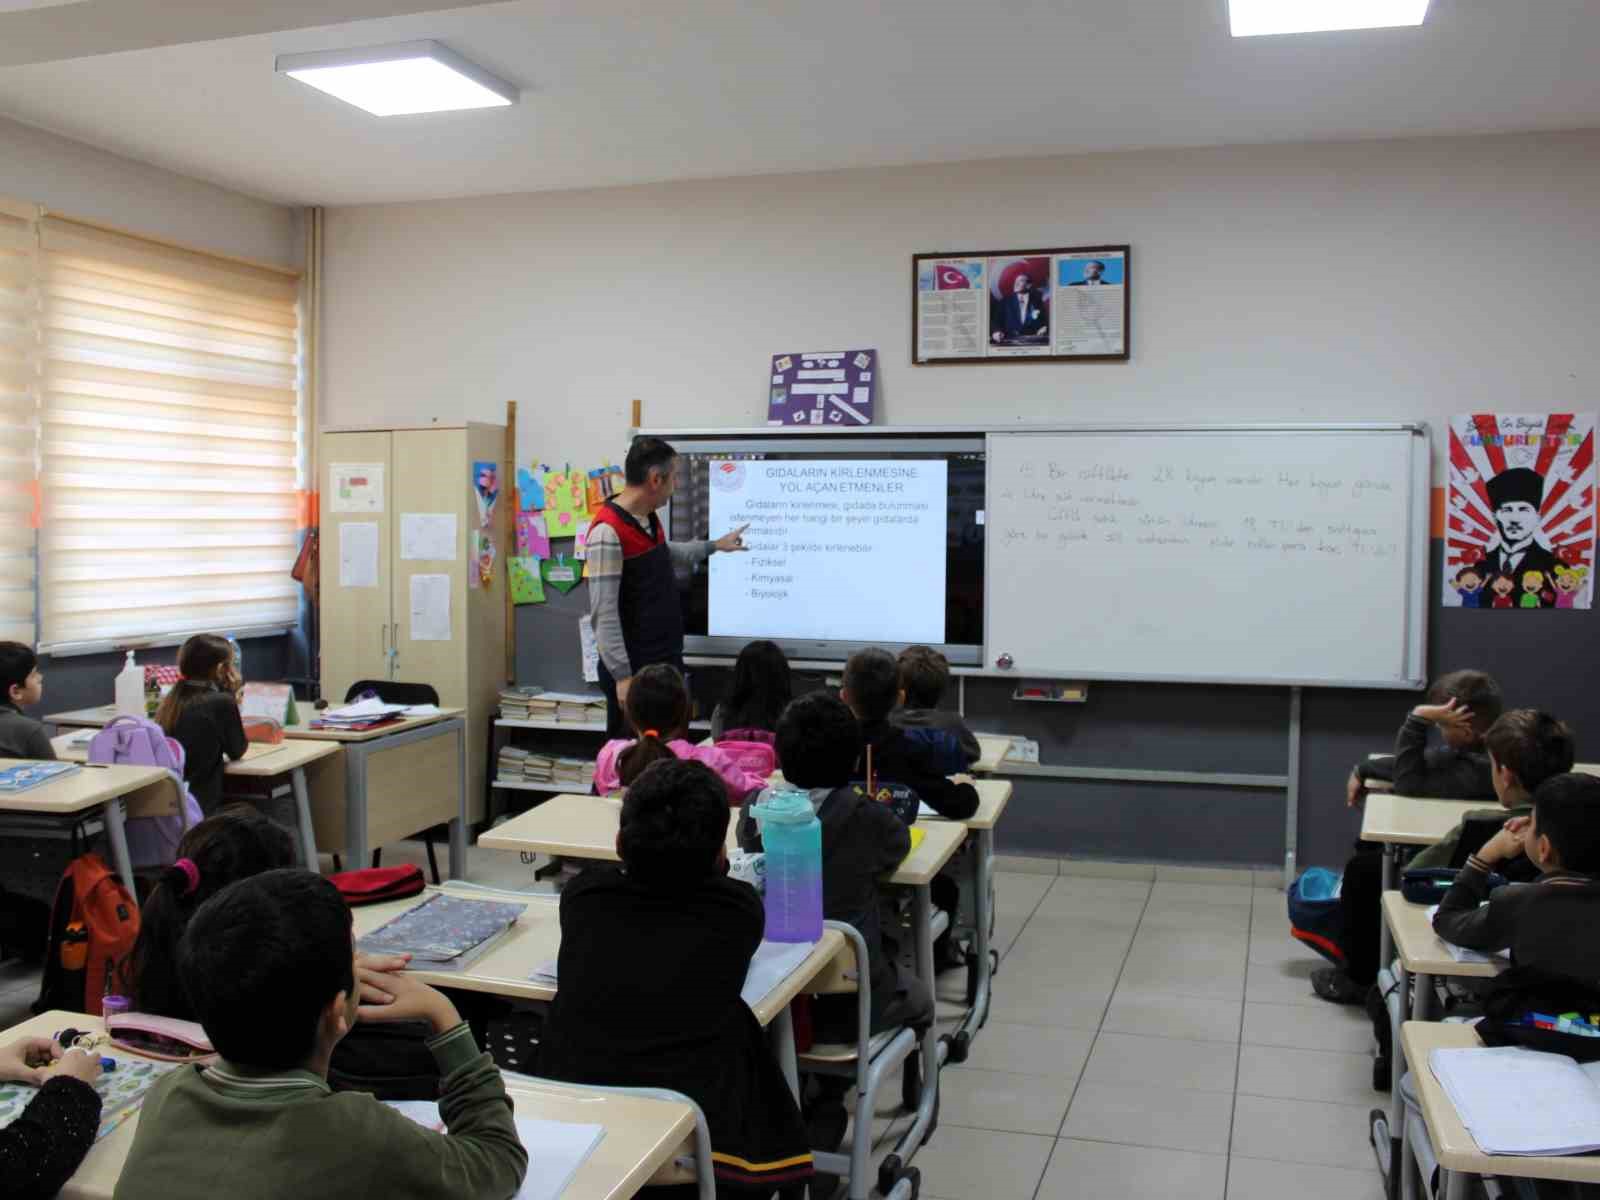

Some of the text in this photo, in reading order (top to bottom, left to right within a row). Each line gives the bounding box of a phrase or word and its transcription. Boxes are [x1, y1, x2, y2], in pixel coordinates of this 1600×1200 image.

[766, 467, 827, 478] GIDALARIN
[780, 482, 904, 495] YOL AÇAN ETMENLER
[752, 557, 786, 567] Fiziksel
[752, 573, 793, 585] Kimyasal
